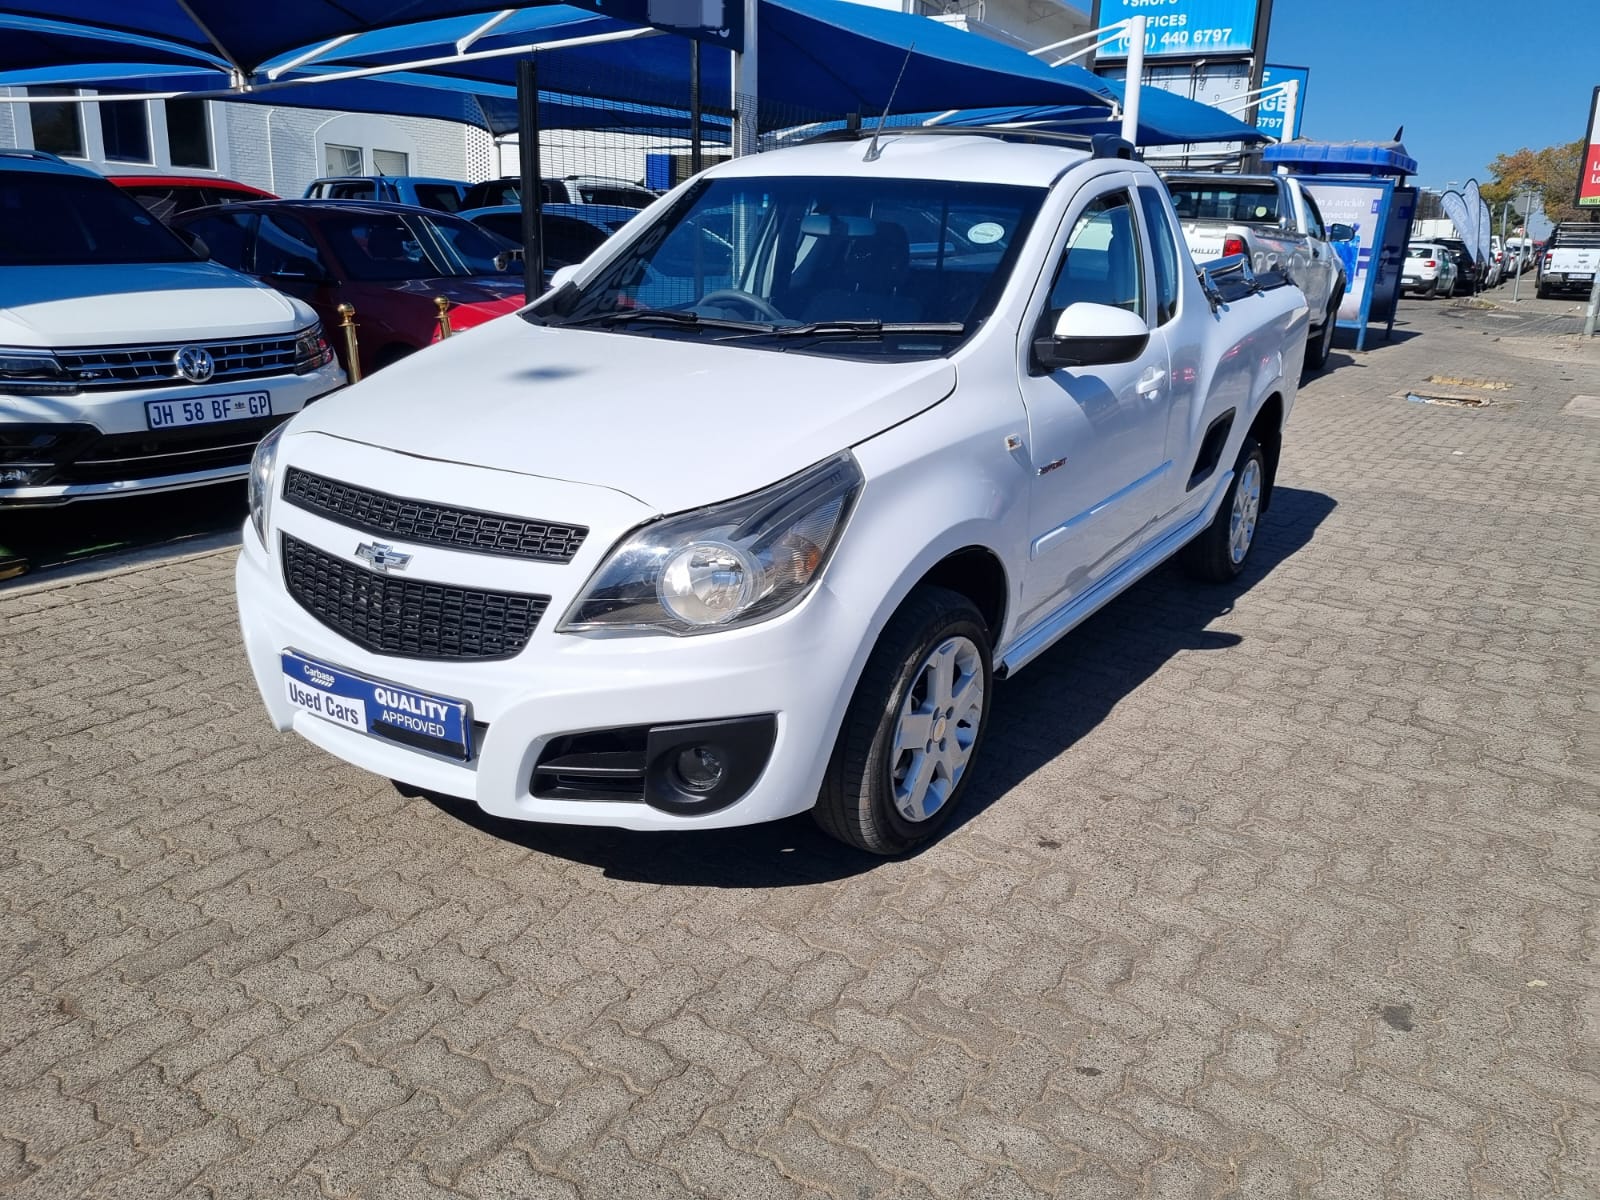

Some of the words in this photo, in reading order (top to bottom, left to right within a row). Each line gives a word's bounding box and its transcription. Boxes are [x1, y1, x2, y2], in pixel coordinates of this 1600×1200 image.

[1146, 14, 1187, 28] FICES
[1118, 32, 1156, 50] (01)
[1160, 31, 1189, 45] 440
[1193, 28, 1232, 43] 6797
[1259, 95, 1287, 112] GE
[1190, 247, 1221, 255] HILUX
[152, 404, 175, 426] JH
[182, 402, 205, 422] 58
[211, 399, 231, 419] BF
[248, 395, 267, 415] GP
[303, 665, 335, 683] Carbase
[289, 682, 323, 712] Used
[325, 695, 360, 725] Cars
[374, 687, 449, 722] QUALITY
[382, 709, 446, 738] APPROVED
